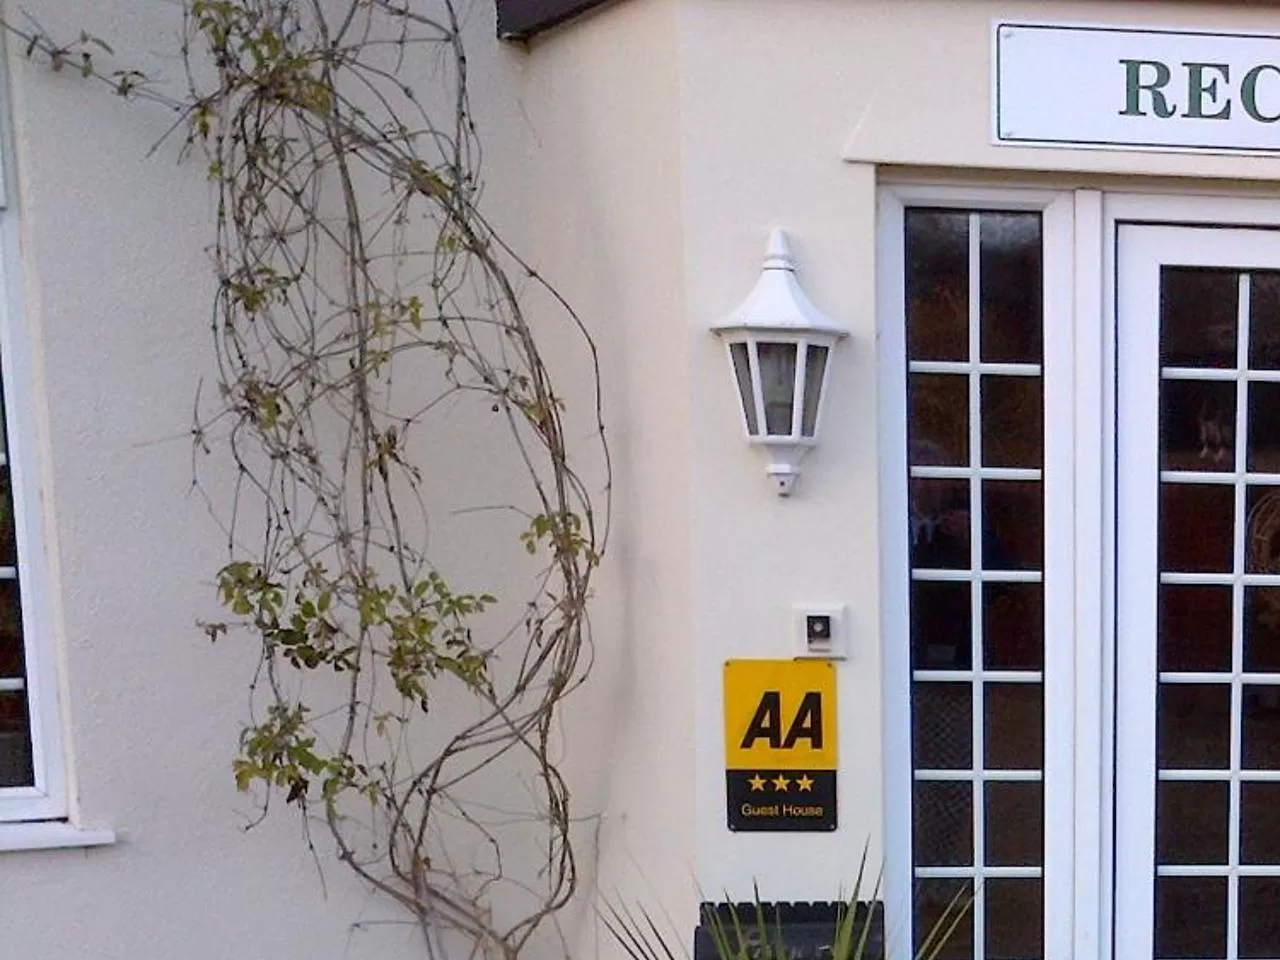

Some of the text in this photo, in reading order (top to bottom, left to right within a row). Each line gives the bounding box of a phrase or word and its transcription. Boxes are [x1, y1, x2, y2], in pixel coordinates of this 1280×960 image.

[740, 691, 823, 749] AA
[741, 803, 823, 816] Guest House
